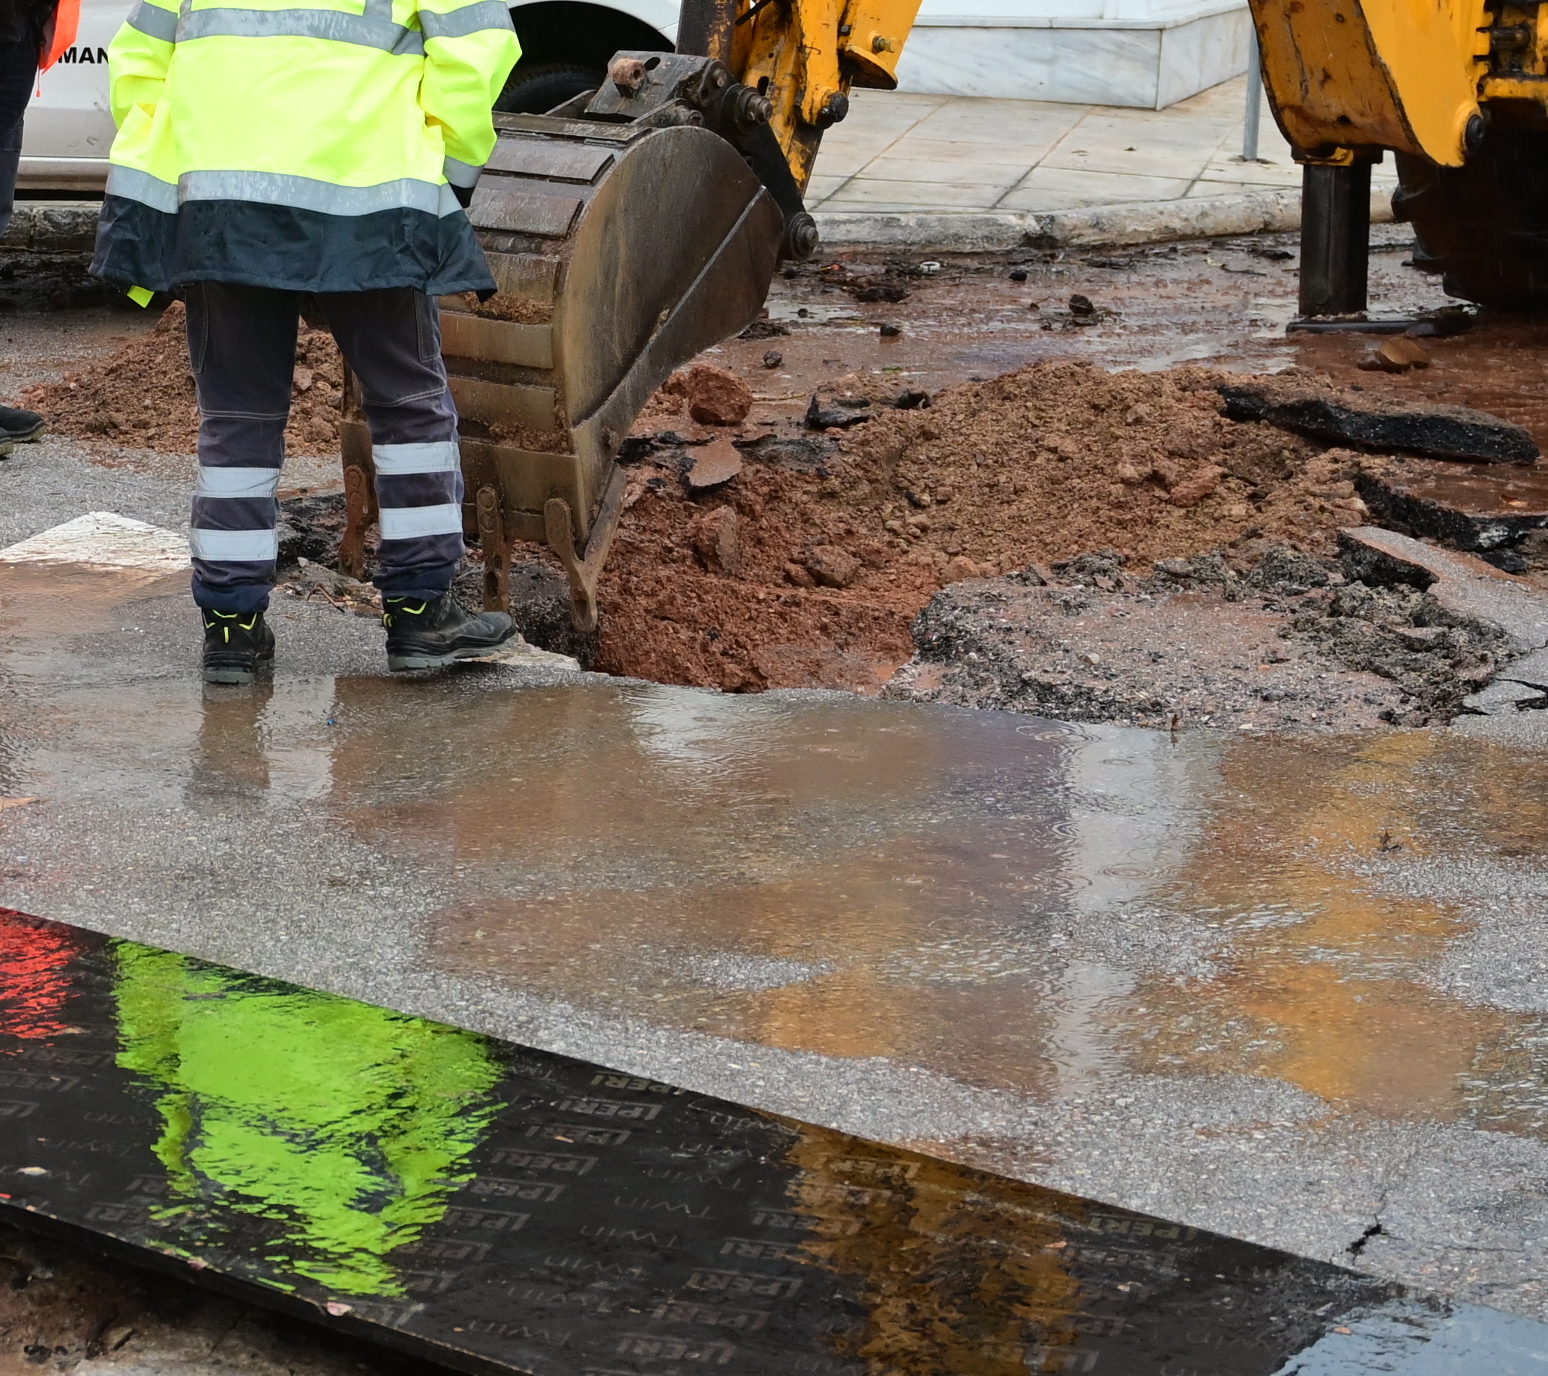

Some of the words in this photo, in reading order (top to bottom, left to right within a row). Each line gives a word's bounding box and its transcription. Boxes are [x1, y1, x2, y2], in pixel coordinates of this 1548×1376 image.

[558, 1099, 644, 1119] PERI
[489, 1149, 579, 1172] PERI
[615, 1337, 715, 1363] PERI
